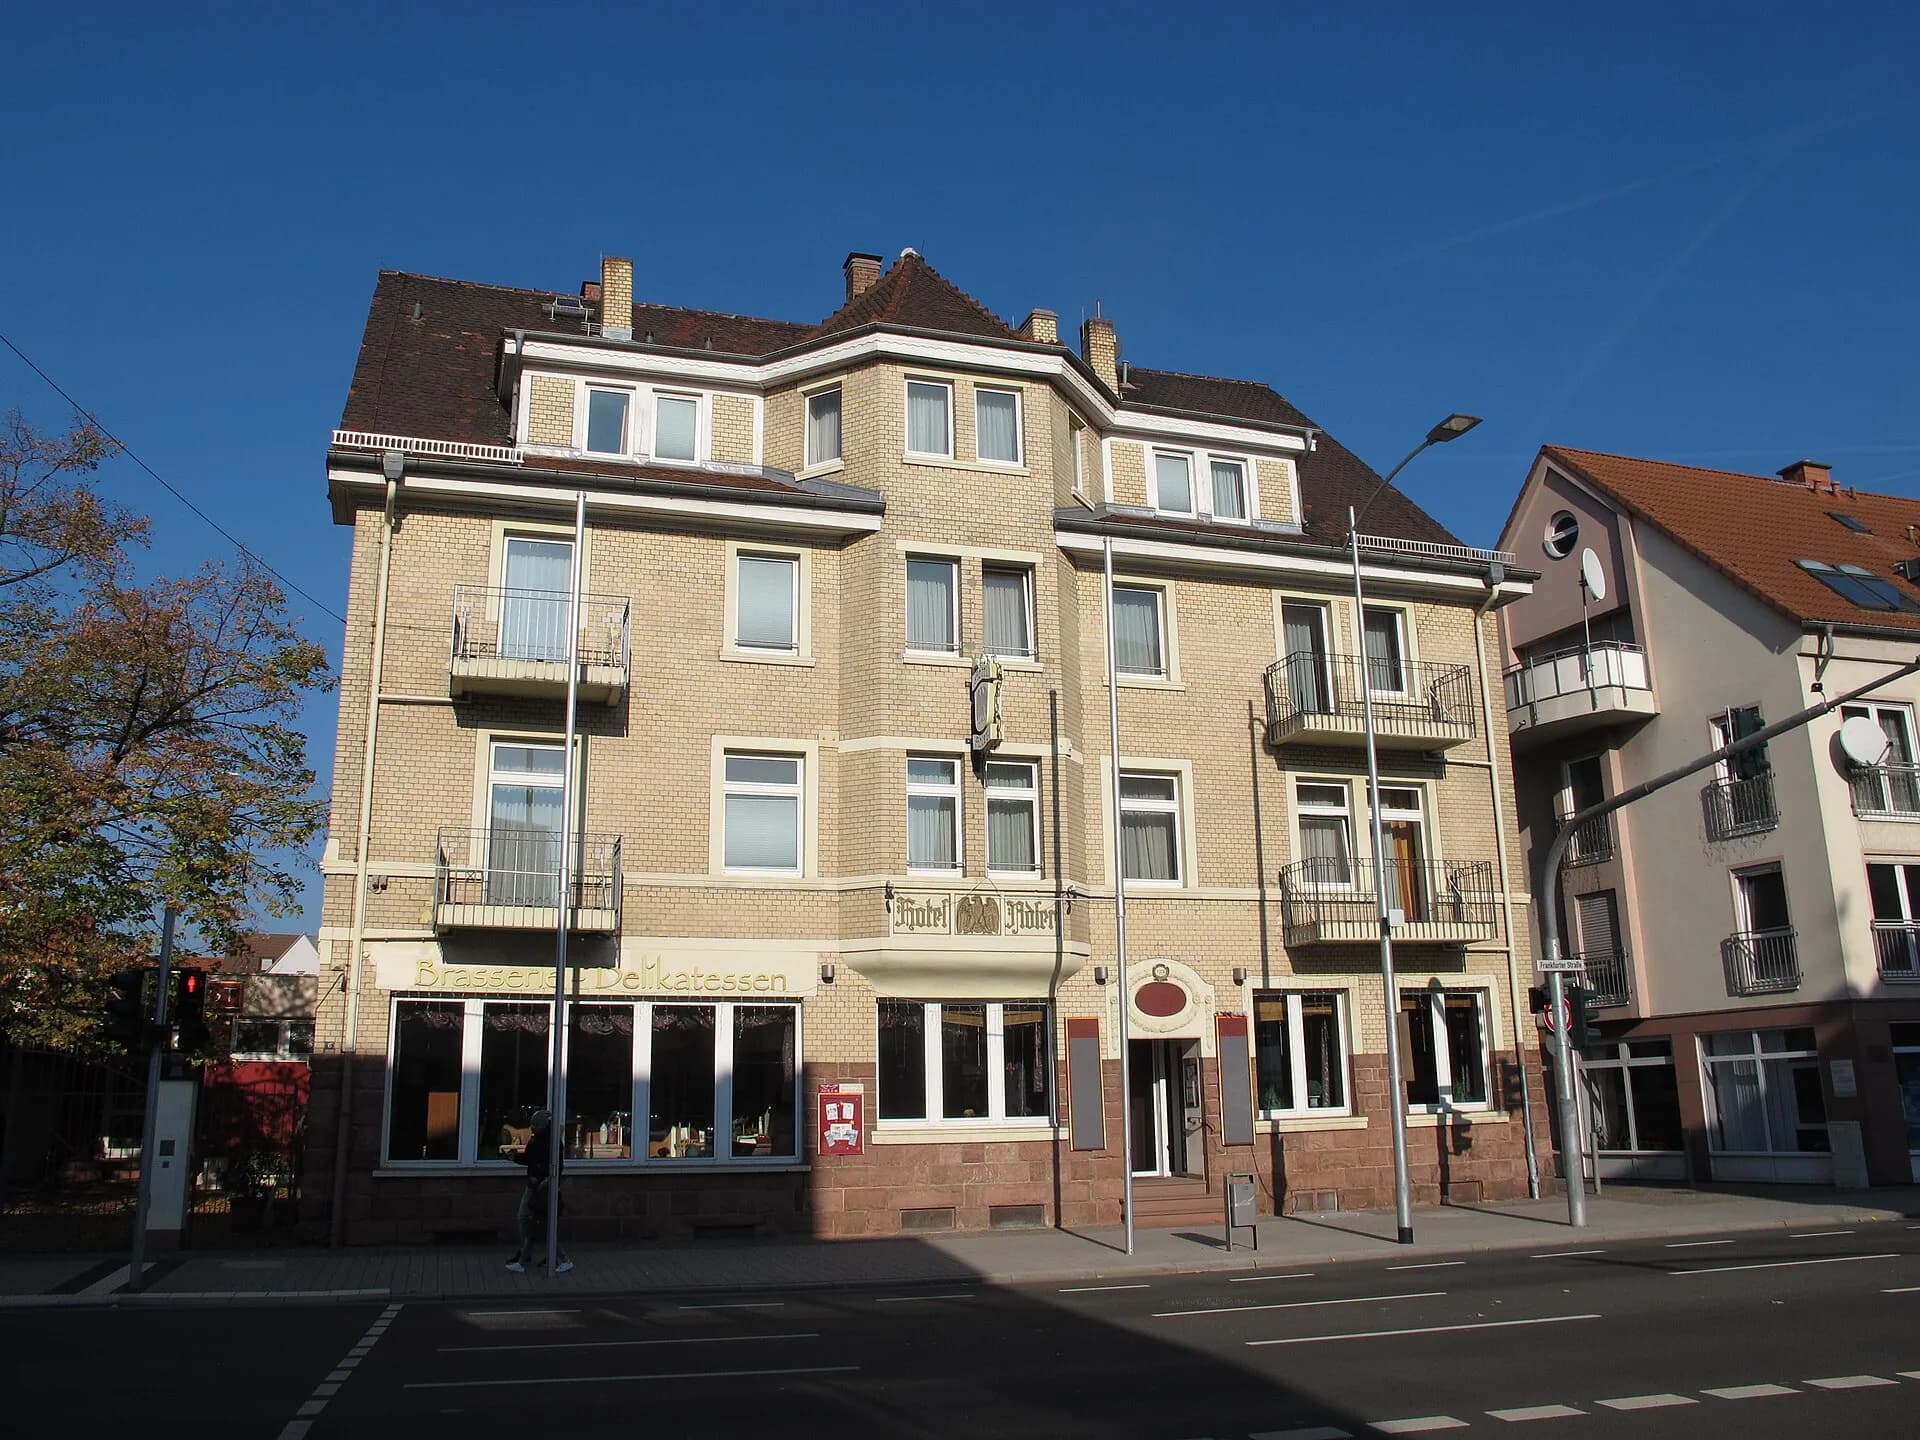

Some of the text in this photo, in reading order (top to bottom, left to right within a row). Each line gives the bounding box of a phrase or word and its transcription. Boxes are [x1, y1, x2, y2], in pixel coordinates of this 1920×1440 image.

[895, 897, 947, 931] Hotel
[415, 960, 557, 988] Brasserie
[595, 954, 787, 991] Delikatessen
